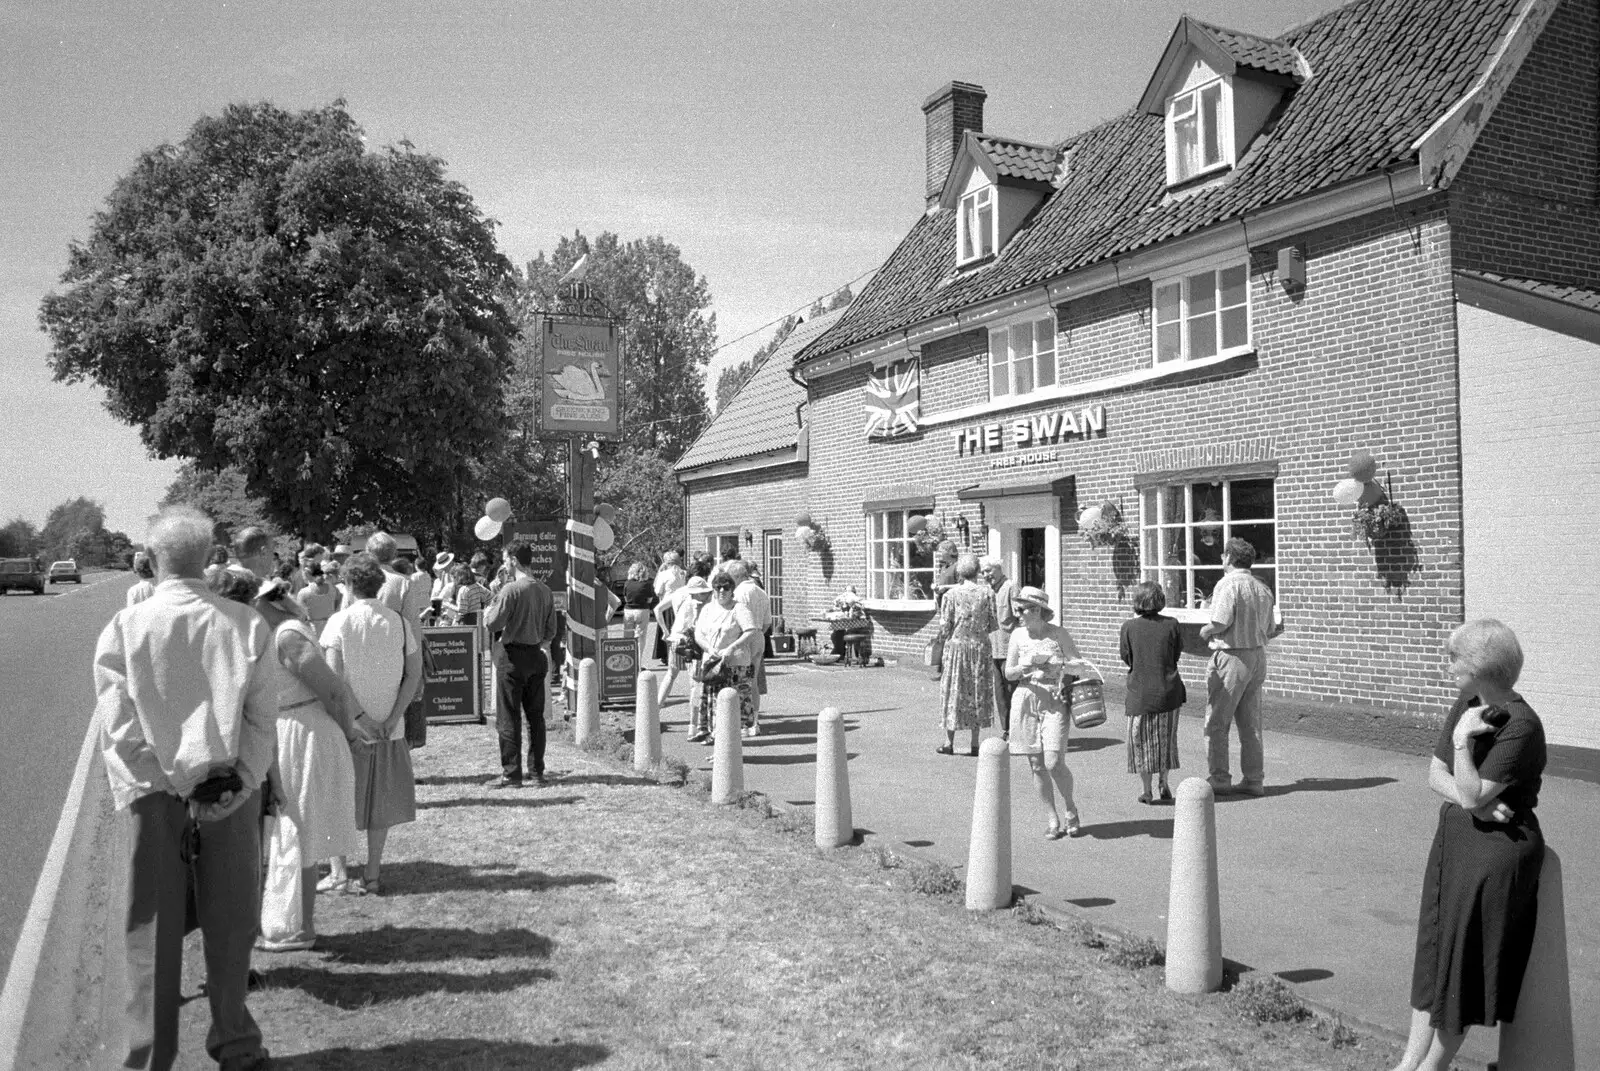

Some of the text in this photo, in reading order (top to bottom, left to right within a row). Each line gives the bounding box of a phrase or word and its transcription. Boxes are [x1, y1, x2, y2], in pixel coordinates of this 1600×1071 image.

[551, 333, 611, 352] The Swan
[950, 405, 1104, 452] THE SWAN
[990, 450, 1059, 468] FREE HOUSE
[530, 542, 558, 552] Snacks
[531, 554, 553, 563] nches
[429, 639, 465, 648] Home Made
[431, 647, 468, 656] aily Specials
[450, 674, 469, 682] Lunch
[438, 704, 456, 712] Menu
